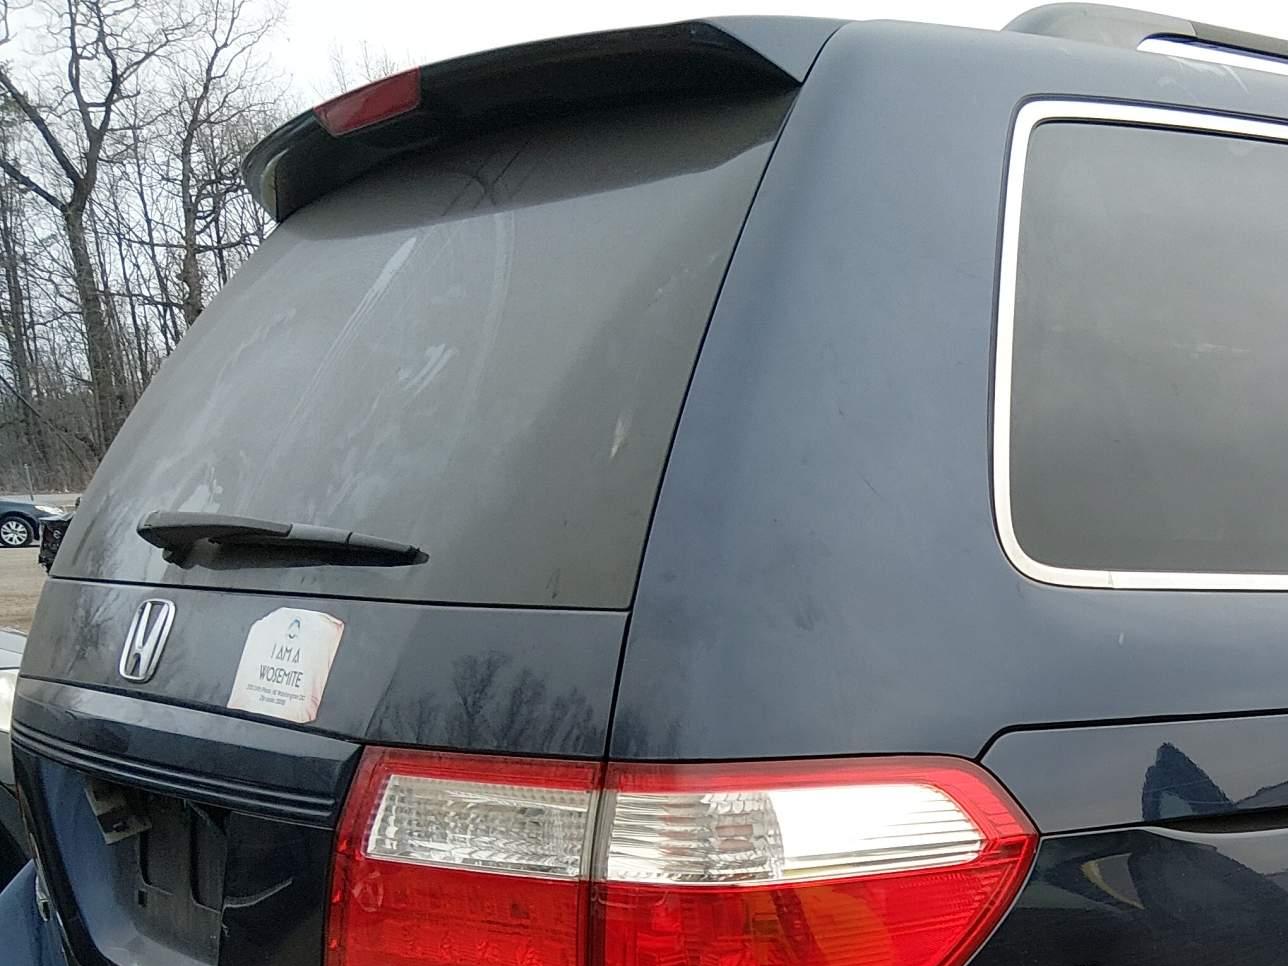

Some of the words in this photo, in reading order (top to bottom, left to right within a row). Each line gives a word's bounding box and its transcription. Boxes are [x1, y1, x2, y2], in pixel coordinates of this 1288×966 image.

[271, 643, 277, 658] I
[276, 645, 292, 662] AM
[292, 647, 300, 663] A
[260, 665, 303, 688] WOSEMITE
